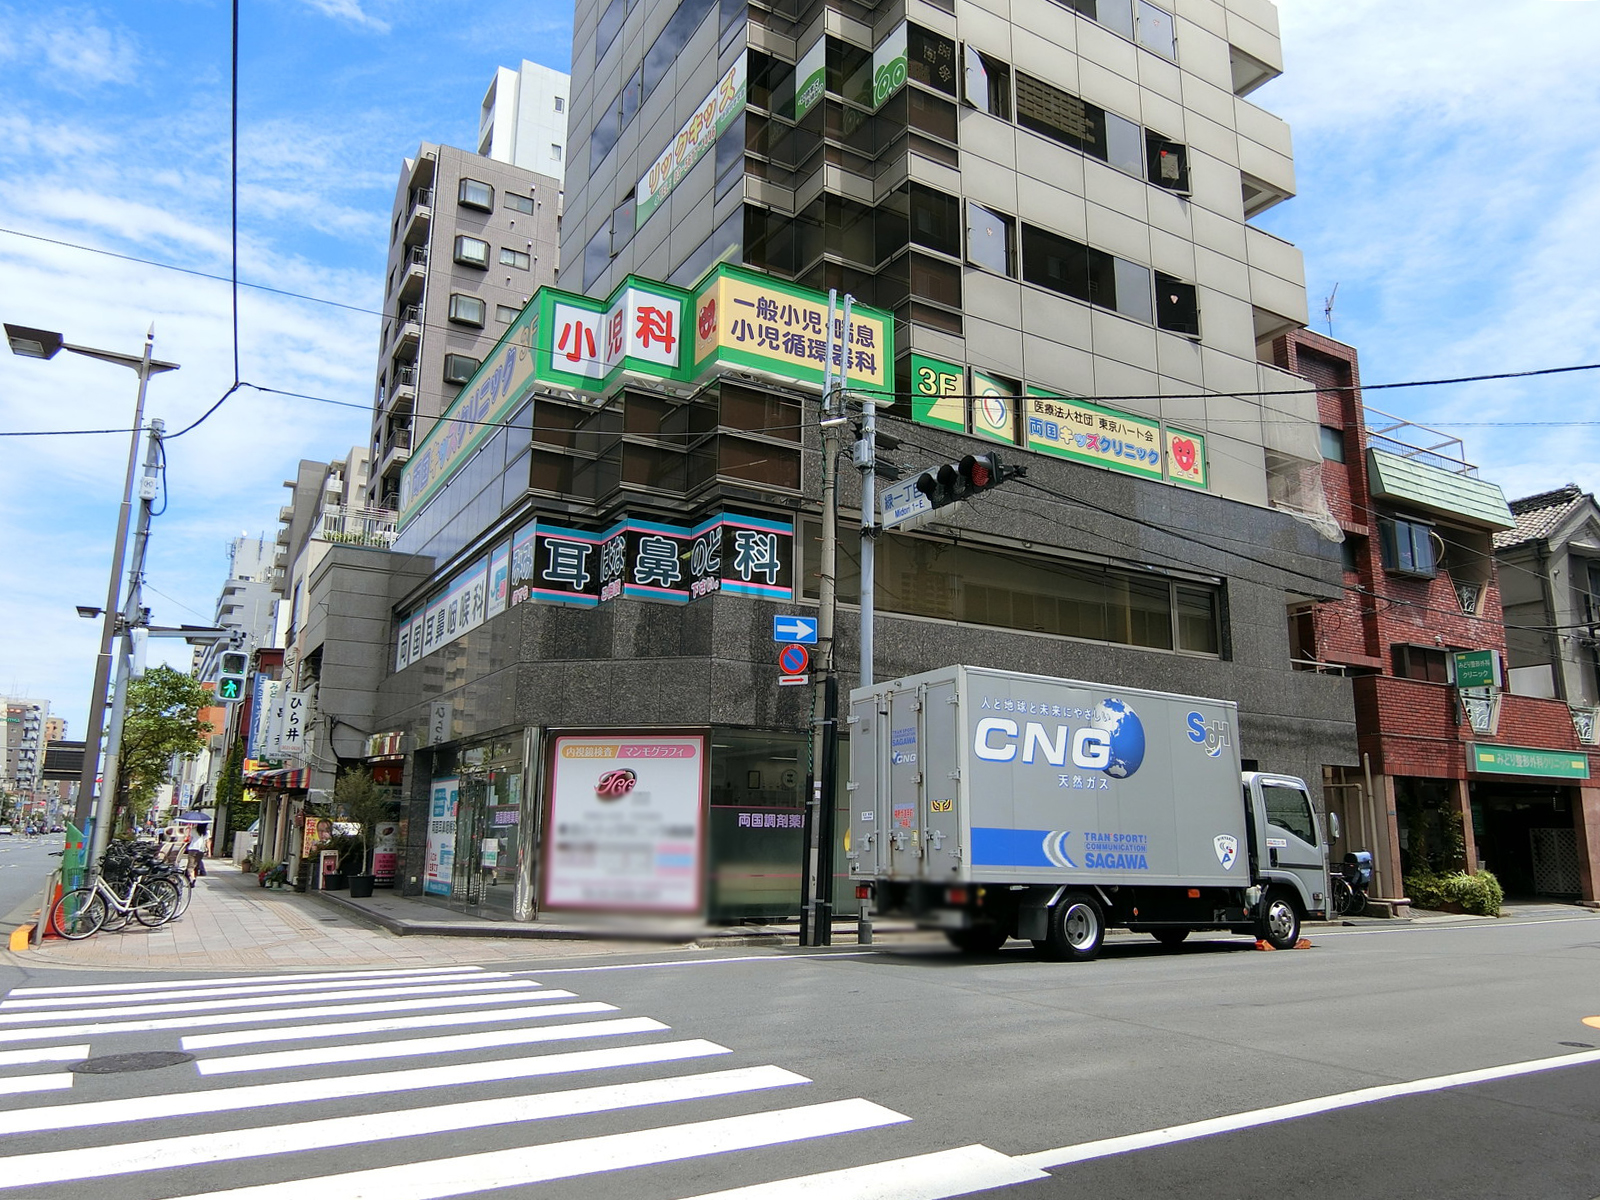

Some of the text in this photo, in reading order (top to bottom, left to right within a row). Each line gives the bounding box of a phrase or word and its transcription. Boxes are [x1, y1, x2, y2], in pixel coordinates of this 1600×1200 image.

[648, 66, 736, 195] リックキッズ
[558, 305, 676, 363] 小児科
[731, 319, 877, 376] 小児循環器科
[918, 366, 957, 398] 3F
[411, 347, 516, 501] 両国キッズクリニック
[1028, 415, 1160, 466] 両国キッズクリニック
[1034, 399, 1154, 443] 医療法人社団 東京ハート会
[542, 538, 592, 590] 耳
[600, 536, 626, 583] はな
[634, 535, 682, 587] 鼻
[691, 526, 722, 577] のど
[733, 530, 781, 585] 科
[401, 580, 484, 663] 両国耳鼻咽喉科
[1462, 670, 1488, 679] クリニック
[286, 697, 303, 742] ひら井
[981, 697, 1112, 723] 人と地球と未来にやさしい
[566, 747, 684, 757] 内視鏡検査 マンモグラフィ
[896, 753, 917, 764] CNG
[974, 716, 1112, 770] CNG
[1058, 773, 1110, 790] 天然ガス
[738, 813, 806, 828] 両国調剤薬
[1085, 843, 1146, 852] COMMUNICATION
[1085, 852, 1149, 870] SAGAWA
